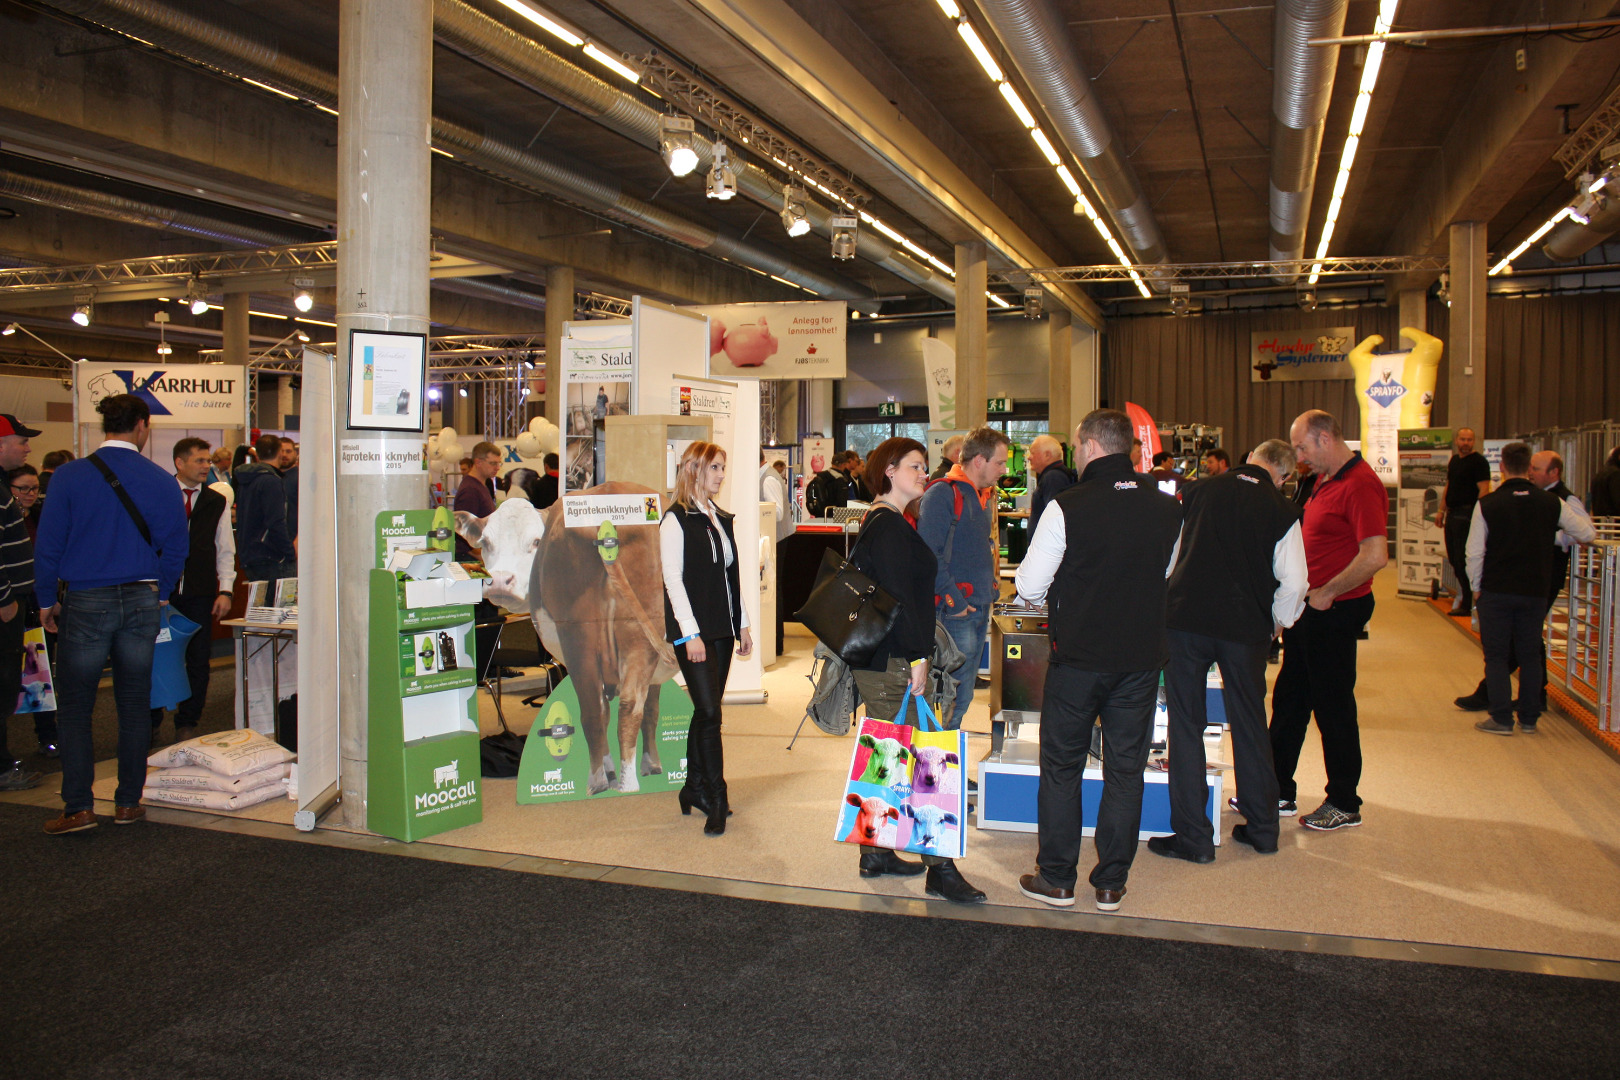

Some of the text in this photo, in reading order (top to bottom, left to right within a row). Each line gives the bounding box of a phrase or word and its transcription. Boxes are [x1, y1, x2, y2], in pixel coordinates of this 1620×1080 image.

[793, 317, 820, 325] Anlegg
[1258, 338, 1316, 354] Husdyr
[1276, 349, 1348, 367] Systemer
[131, 377, 236, 394] KNARRHULT
[1370, 386, 1404, 396] SPRAYFO
[202, 399, 232, 408] bättre
[342, 451, 420, 463] Agroteknkknyhet
[567, 506, 642, 517] Agroteknikknyhet
[382, 526, 415, 536] Moocall
[531, 781, 574, 793] Moocall
[415, 780, 476, 810] Moocall
[416, 808, 440, 817] monitoring
